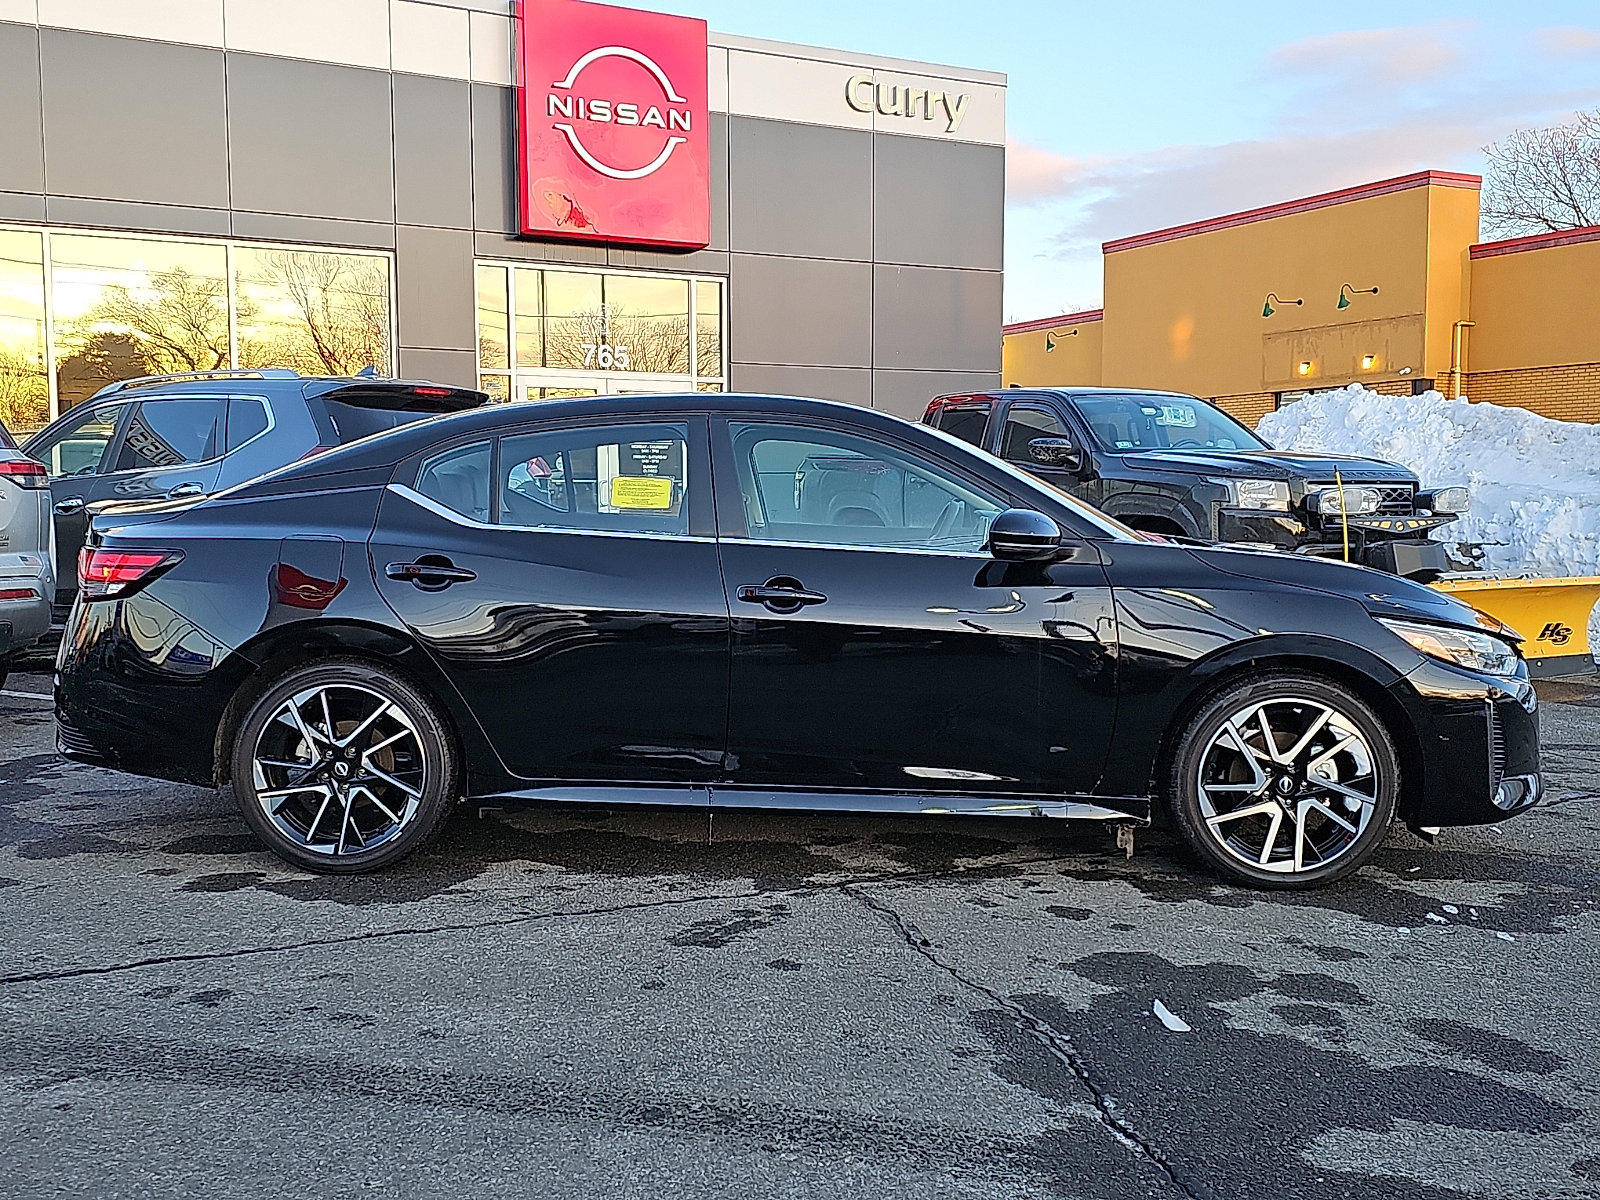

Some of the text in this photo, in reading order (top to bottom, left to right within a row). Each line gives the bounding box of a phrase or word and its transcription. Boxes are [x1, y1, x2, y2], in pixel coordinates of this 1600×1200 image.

[547, 93, 691, 132] NISSAN
[845, 73, 970, 133] Curry
[580, 343, 629, 369] 765
